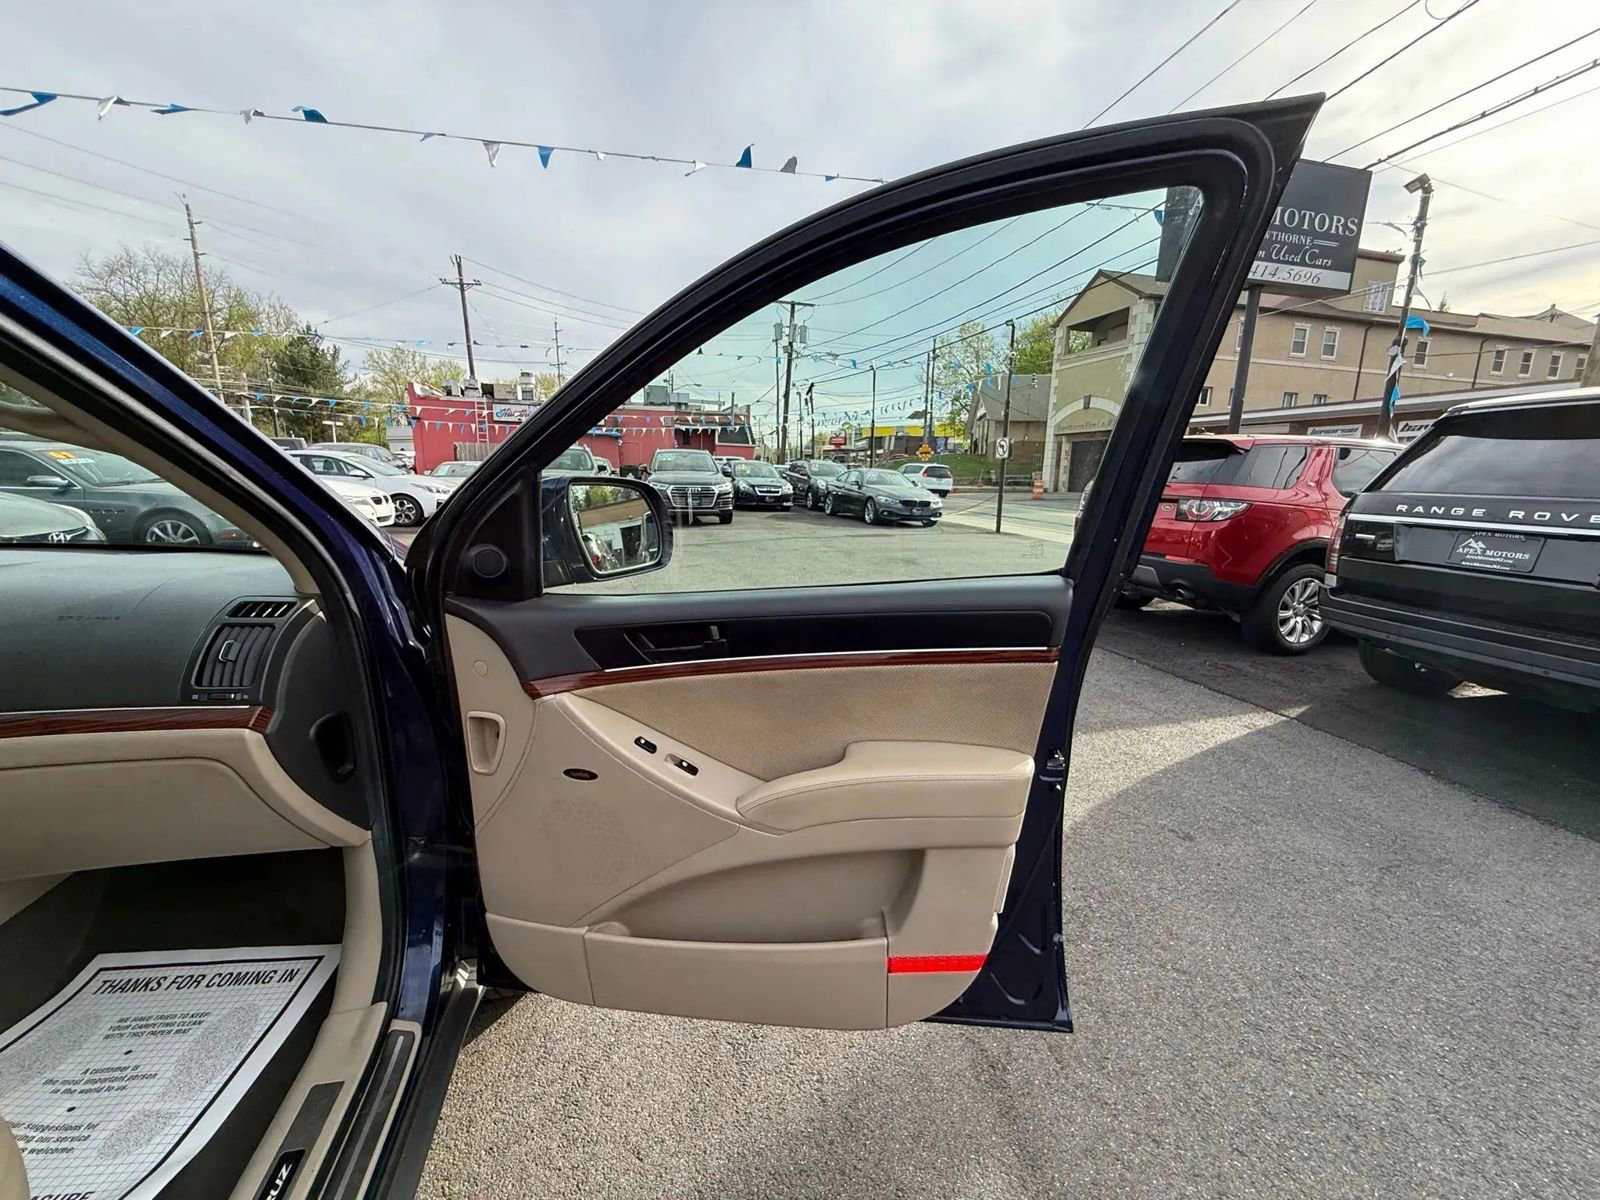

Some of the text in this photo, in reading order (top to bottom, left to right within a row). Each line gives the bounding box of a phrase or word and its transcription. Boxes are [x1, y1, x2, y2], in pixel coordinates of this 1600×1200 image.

[1270, 243, 1309, 262] Used
[1305, 249, 1332, 267] Cars
[1395, 504, 1600, 524] RANGE ROVE
[1456, 547, 1531, 560] APEX MOTORS
[92, 968, 301, 995] THANKS FOR COMING IN
[108, 1024, 132, 1032] YOUR
[130, 1020, 176, 1030] CARPETING
[103, 1032, 126, 1040] WITH
[125, 1030, 147, 1038] THIS
[145, 1029, 173, 1037] PAPER
[89, 1065, 131, 1075] customer
[82, 1075, 129, 1085] important
[125, 1072, 158, 1082] person
[78, 1085, 105, 1094] world
[24, 1122, 84, 1133] suggestions
[82, 1121, 100, 1131] for
[53, 1134, 92, 1143] service
